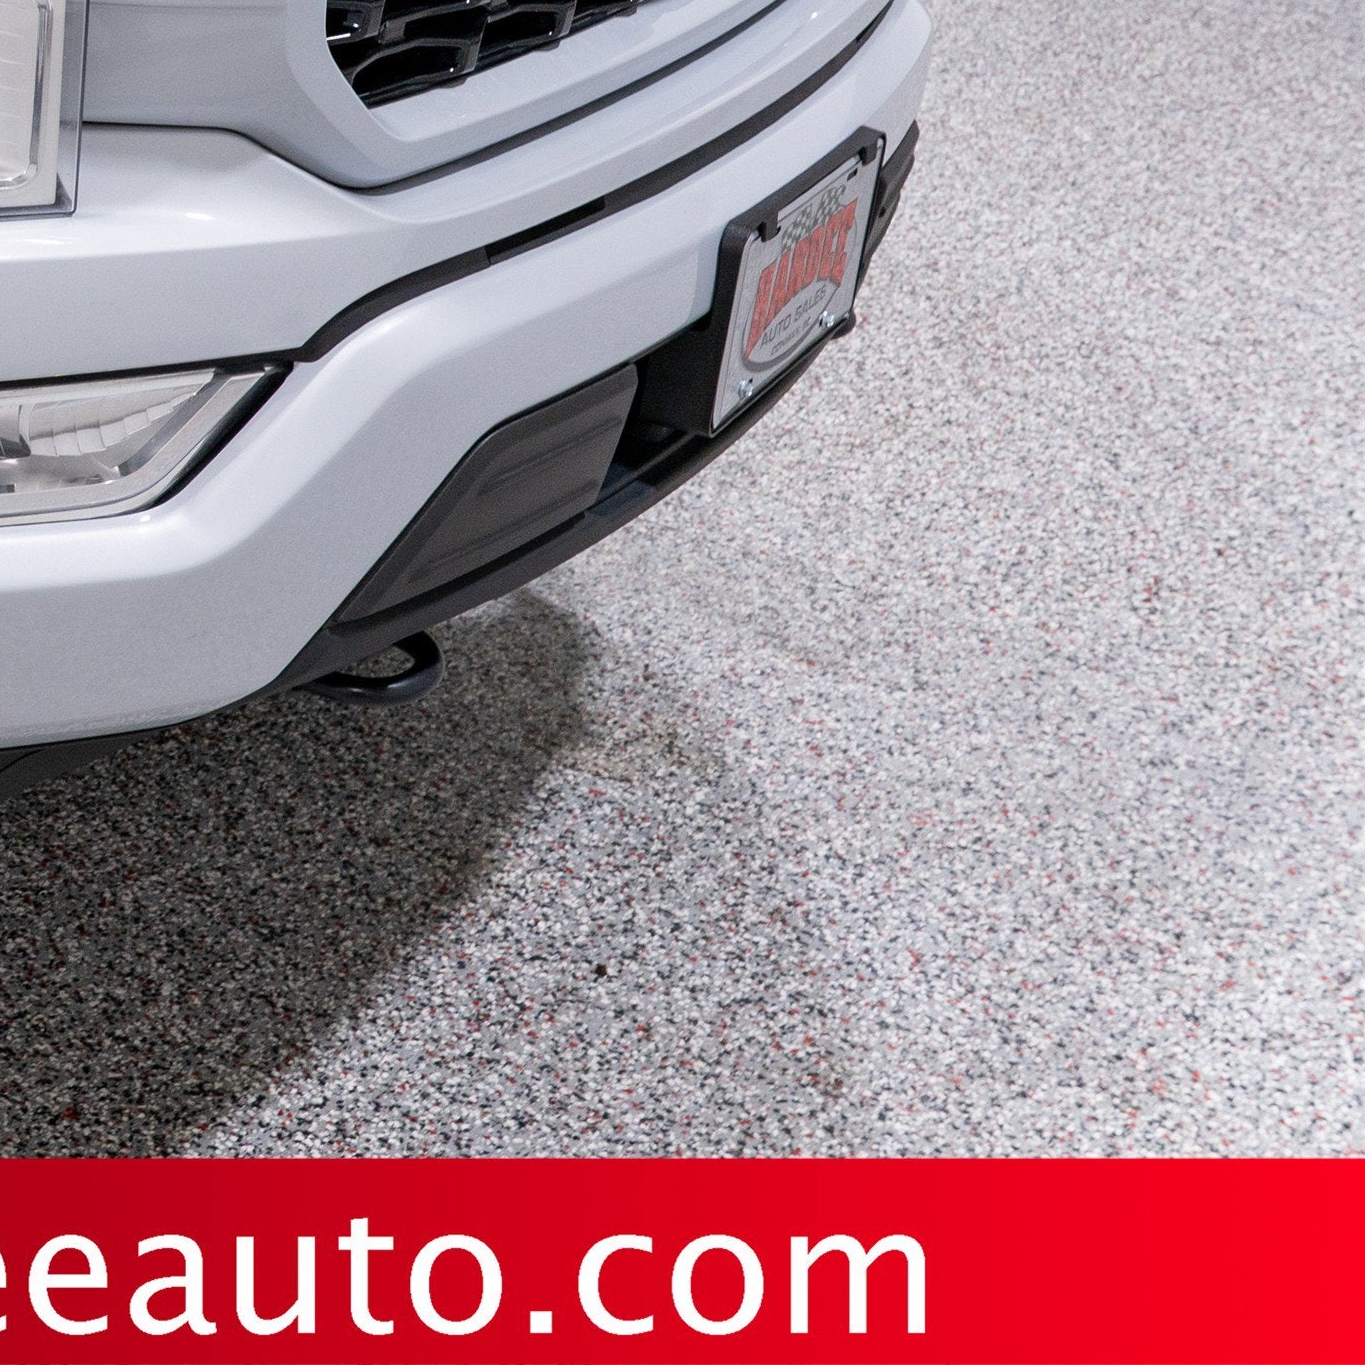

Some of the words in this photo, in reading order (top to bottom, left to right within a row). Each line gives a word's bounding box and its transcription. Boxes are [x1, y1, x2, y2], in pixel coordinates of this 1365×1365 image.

[746, 198, 859, 360] HARDEE
[760, 313, 792, 349] AUTO
[794, 284, 827, 322] SALES
